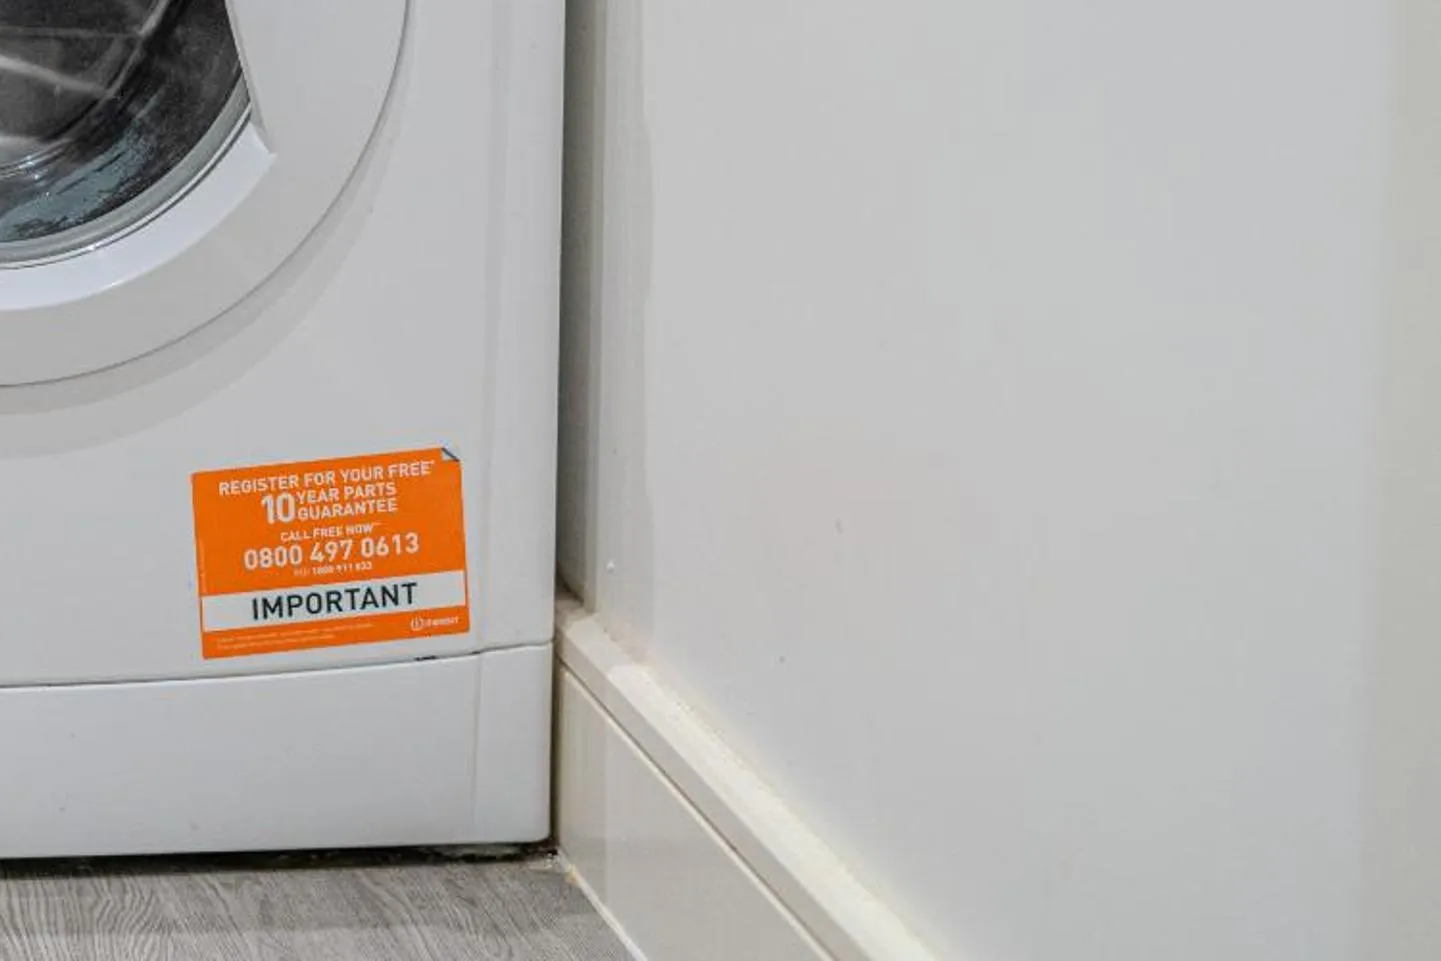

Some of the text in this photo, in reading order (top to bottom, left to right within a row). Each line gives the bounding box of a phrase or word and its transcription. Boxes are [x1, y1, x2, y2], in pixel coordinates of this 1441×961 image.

[219, 474, 299, 496] REGISTER
[303, 471, 335, 488] FOR
[340, 466, 383, 484] YOUR
[262, 482, 396, 525] 10 YEAR PARTS
[297, 499, 398, 522] GUARANTEE
[244, 532, 420, 571] 0800 497 0613
[280, 531, 309, 542] CALL
[312, 527, 344, 539] FREE
[252, 581, 418, 621] IMPORTANT
